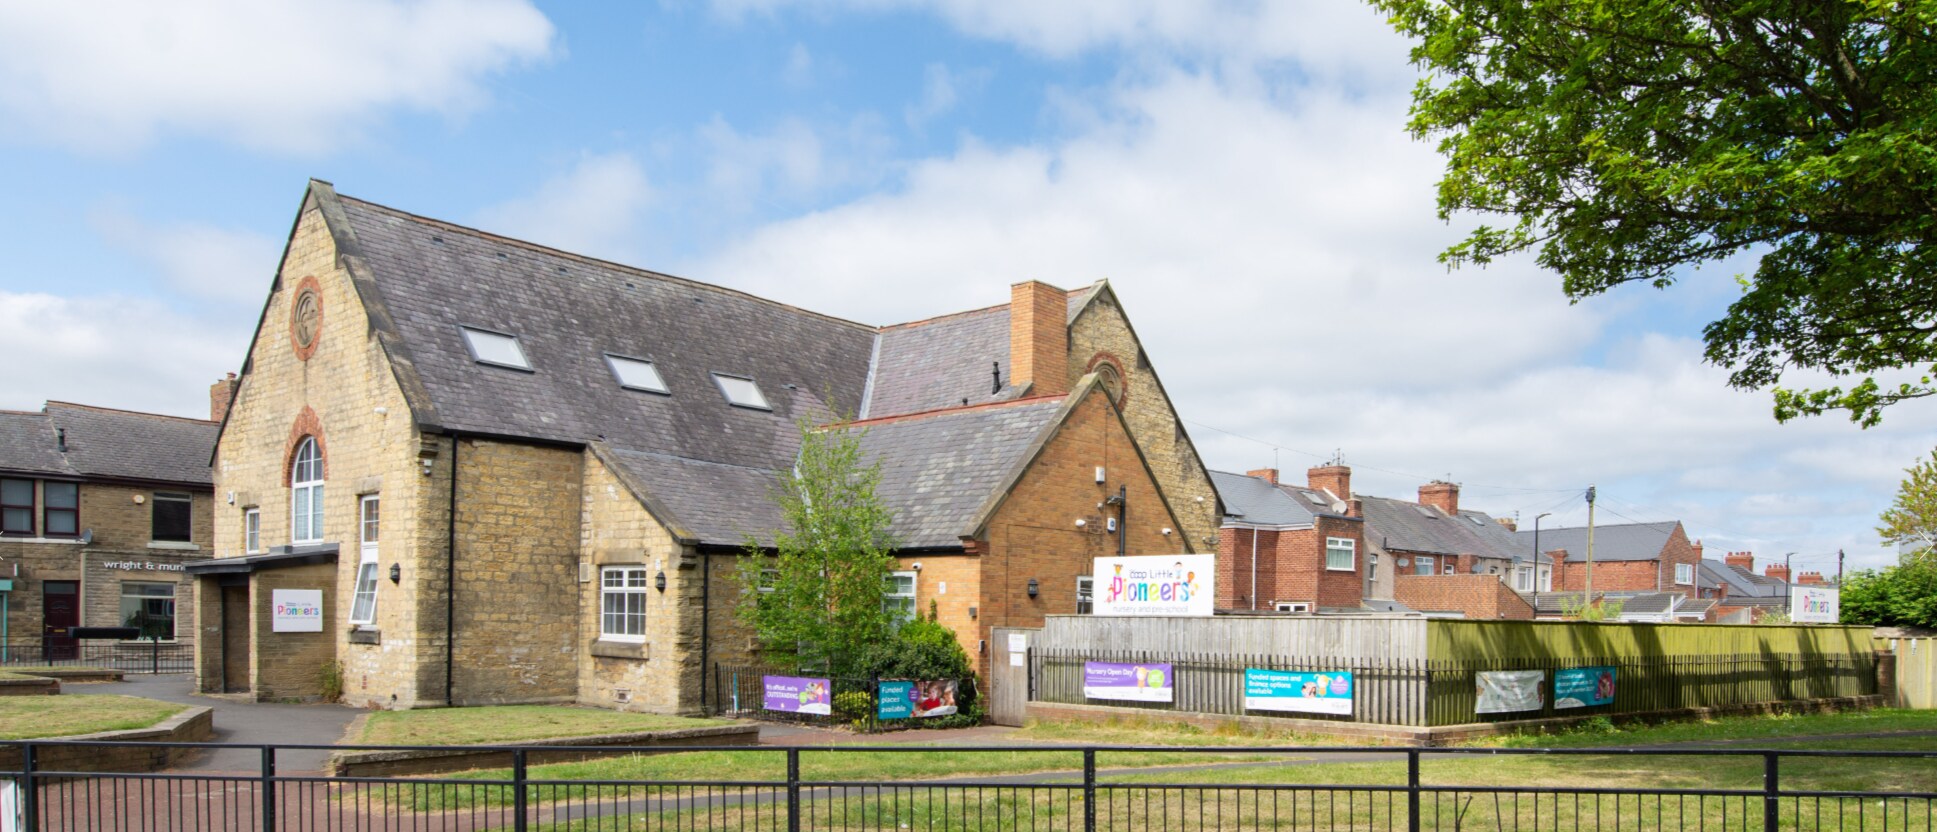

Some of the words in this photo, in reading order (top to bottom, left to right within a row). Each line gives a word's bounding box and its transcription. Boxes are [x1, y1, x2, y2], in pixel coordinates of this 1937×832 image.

[103, 560, 142, 571] wright
[145, 561, 155, 570] &
[158, 563, 186, 571] mun
[1149, 569, 1173, 579] Little
[1113, 576, 1190, 602] Pioneers
[277, 604, 319, 616] Pioneers
[1113, 605, 1136, 614] nursery
[1138, 605, 1151, 613] and
[1152, 605, 1188, 614] pre-school
[1086, 667, 1106, 676] Nursery
[1107, 668, 1122, 676] Open
[1122, 669, 1133, 677] Day
[881, 686, 904, 694] Funded
[881, 697, 900, 705] places
[881, 705, 906, 713] available
